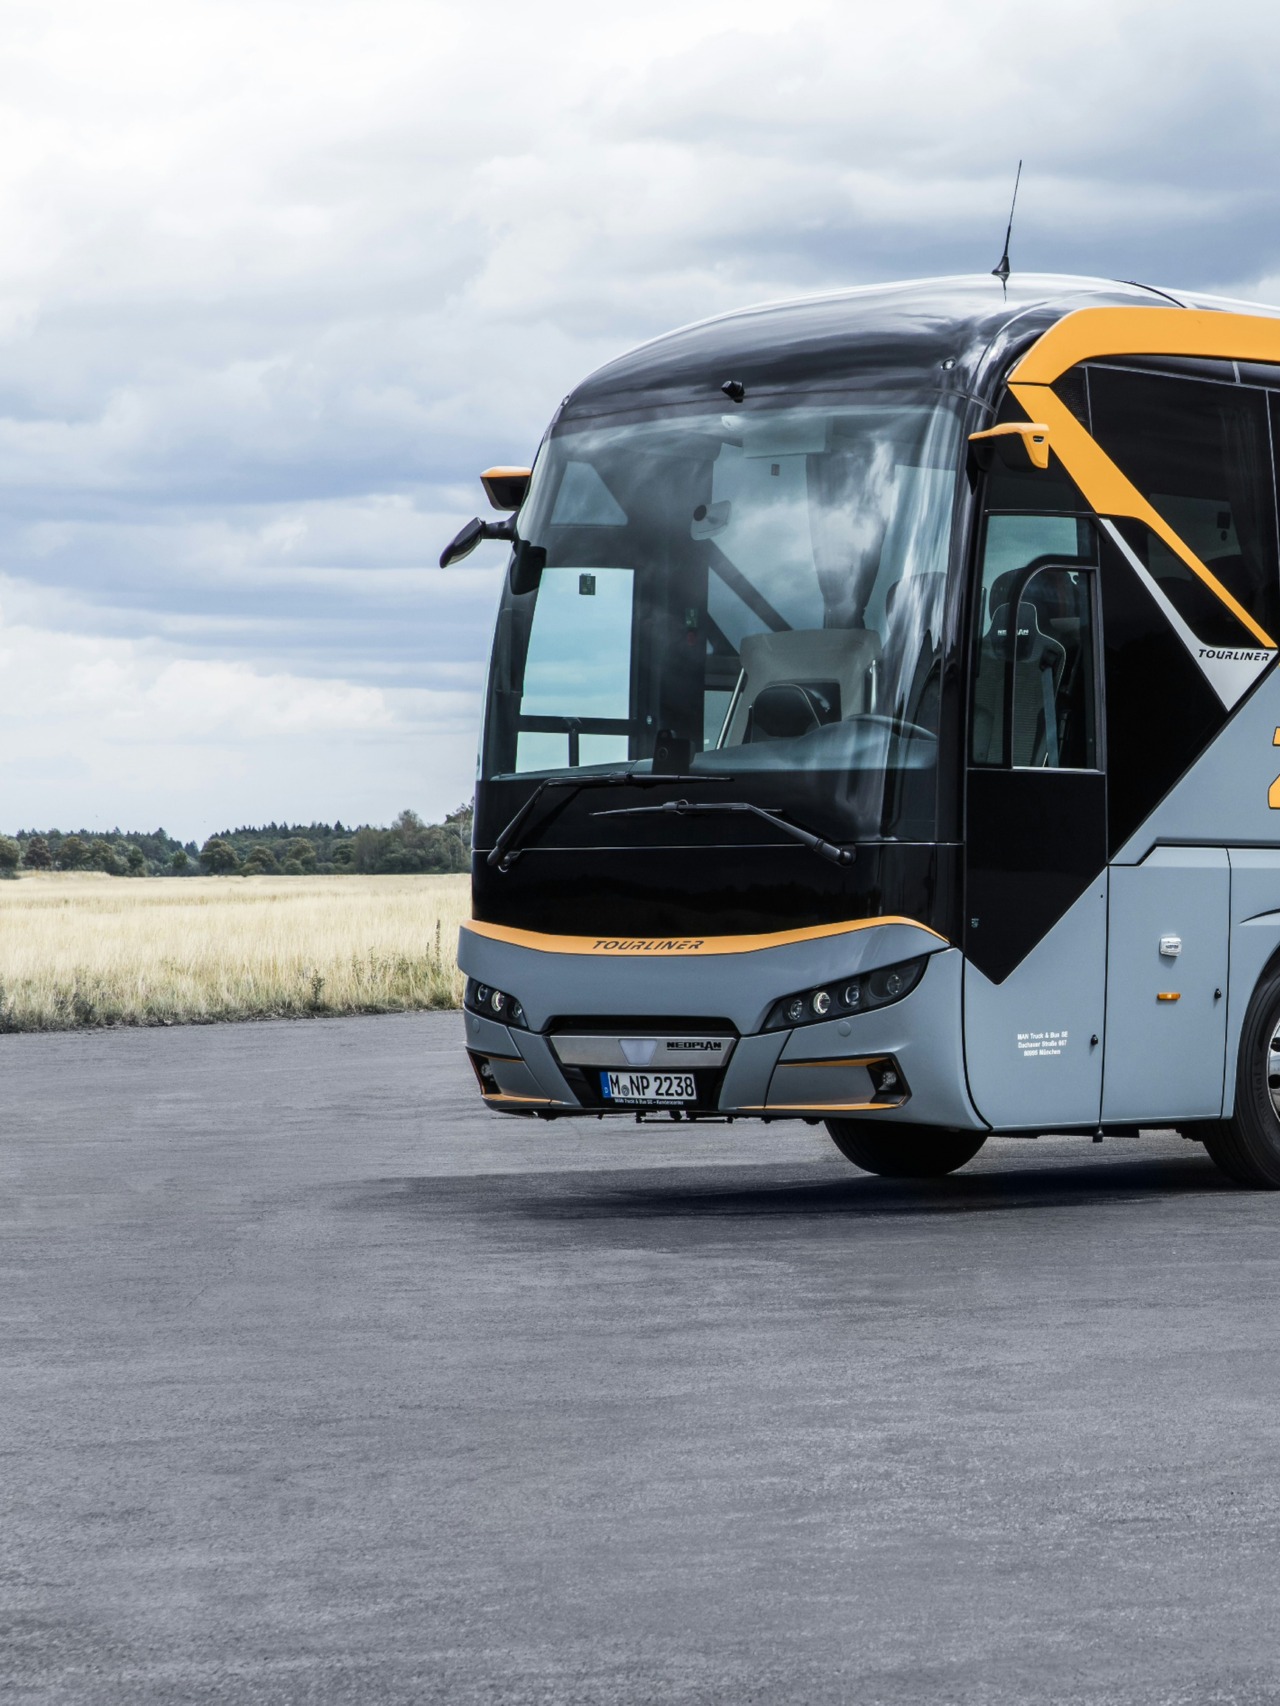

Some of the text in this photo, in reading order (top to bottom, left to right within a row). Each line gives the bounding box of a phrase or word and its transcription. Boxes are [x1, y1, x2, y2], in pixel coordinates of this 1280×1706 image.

[1198, 649, 1270, 661] TOURLINER
[592, 940, 705, 950] TOURLINER
[666, 1040, 722, 1050] NEOPLAN
[609, 1074, 695, 1097] M NP 2238
